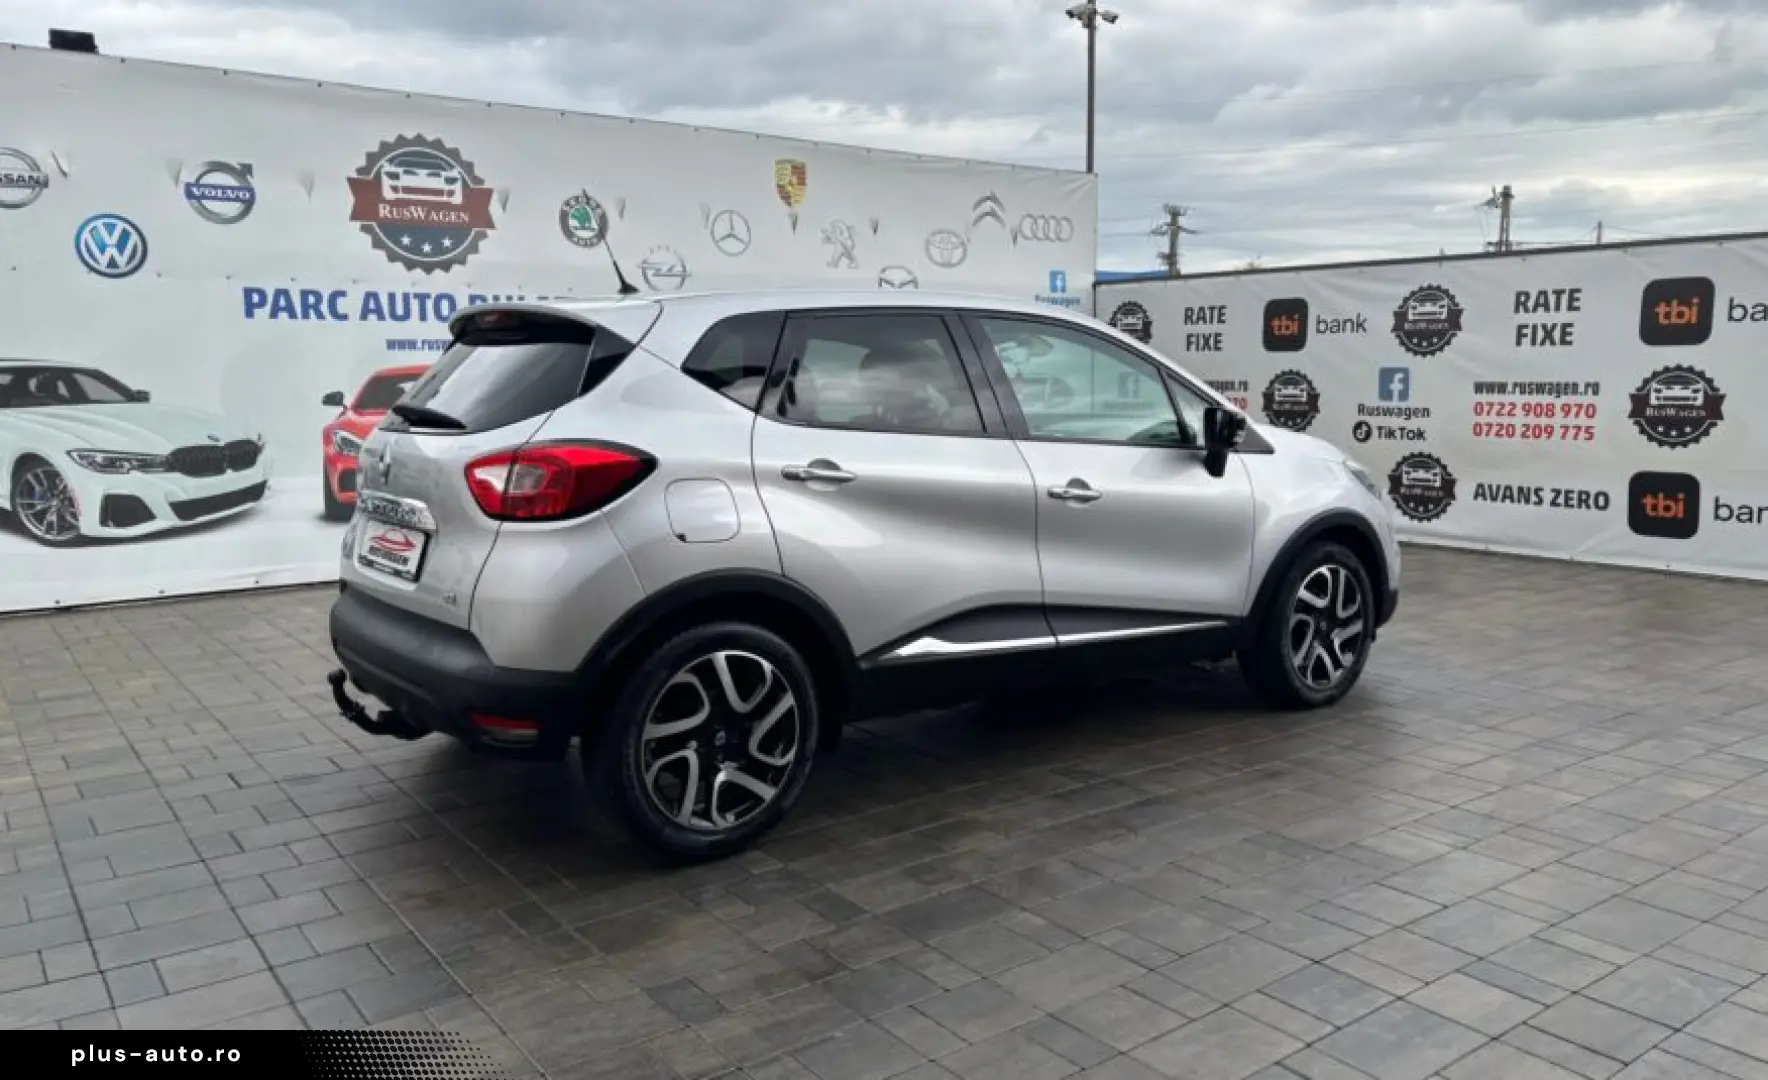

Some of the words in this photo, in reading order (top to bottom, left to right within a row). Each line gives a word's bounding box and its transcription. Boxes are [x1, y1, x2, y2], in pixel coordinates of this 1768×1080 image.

[190, 186, 252, 201] VOLVO
[242, 286, 350, 321] PARC
[359, 291, 457, 324] AUTO
[1514, 287, 1583, 314] RATE
[1655, 296, 1701, 325] tbi
[1184, 305, 1228, 326] RATE
[1270, 314, 1300, 336] tbi
[1315, 312, 1368, 335] bank
[1186, 332, 1224, 352] FIXE
[1515, 323, 1576, 348] FIXE
[1473, 381, 1601, 399] www.ruswagen.ro
[1357, 404, 1431, 421] Ruswagen
[1473, 401, 1517, 418] 0722
[1521, 402, 1556, 419] 908
[1560, 403, 1598, 420] 970
[1376, 425, 1428, 442] TikTok
[1472, 423, 1515, 439] 0720
[1520, 424, 1556, 440] 209
[1560, 425, 1597, 441] 775
[1473, 483, 1543, 506] AVANS
[1549, 486, 1610, 512] ZERO
[1640, 492, 1686, 519] tbi
